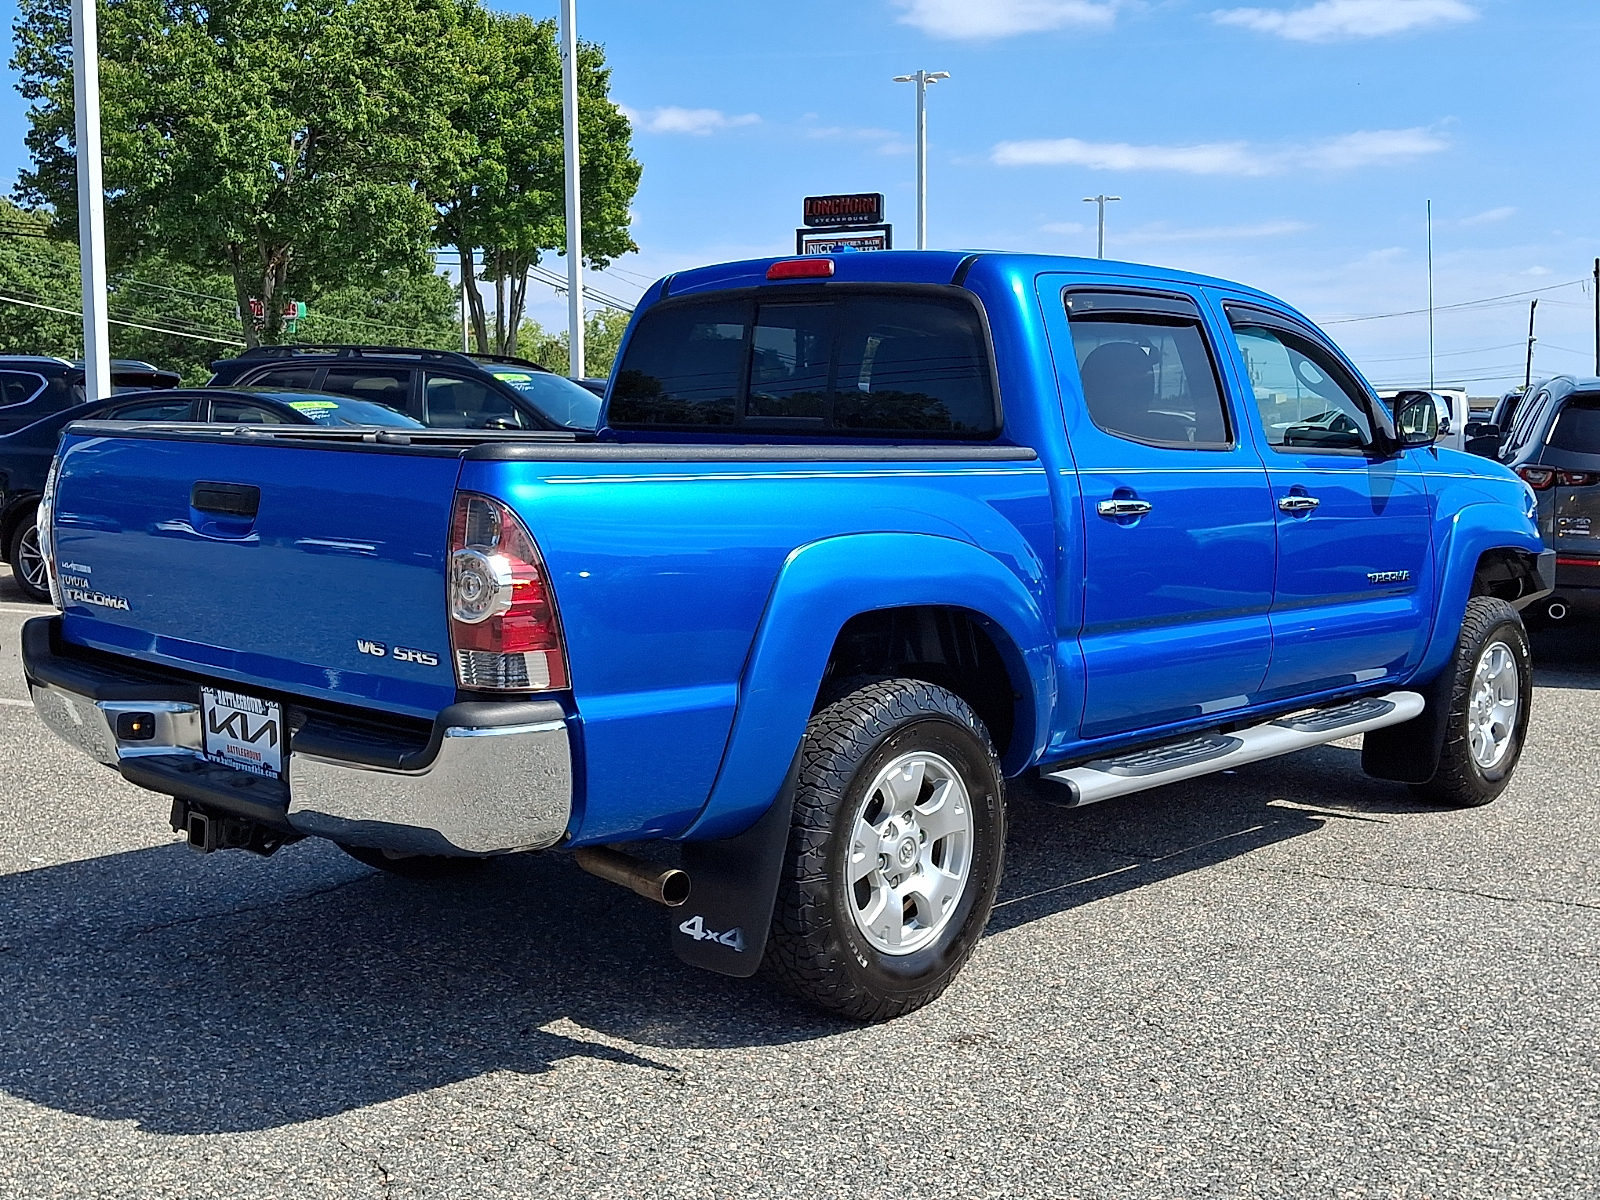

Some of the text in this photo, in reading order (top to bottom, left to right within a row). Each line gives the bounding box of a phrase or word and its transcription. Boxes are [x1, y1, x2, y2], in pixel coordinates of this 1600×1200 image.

[805, 197, 877, 216] LONGHORN
[814, 215, 869, 224] STEAKHOUSE
[61, 574, 90, 589] TOYOTA
[65, 588, 130, 611] TACOMA
[356, 639, 386, 657] V6
[216, 689, 263, 714] BATTLEGROUND
[208, 706, 278, 749] KIA
[226, 744, 262, 762] BATTLEGROUND
[679, 915, 748, 953] 4x4
